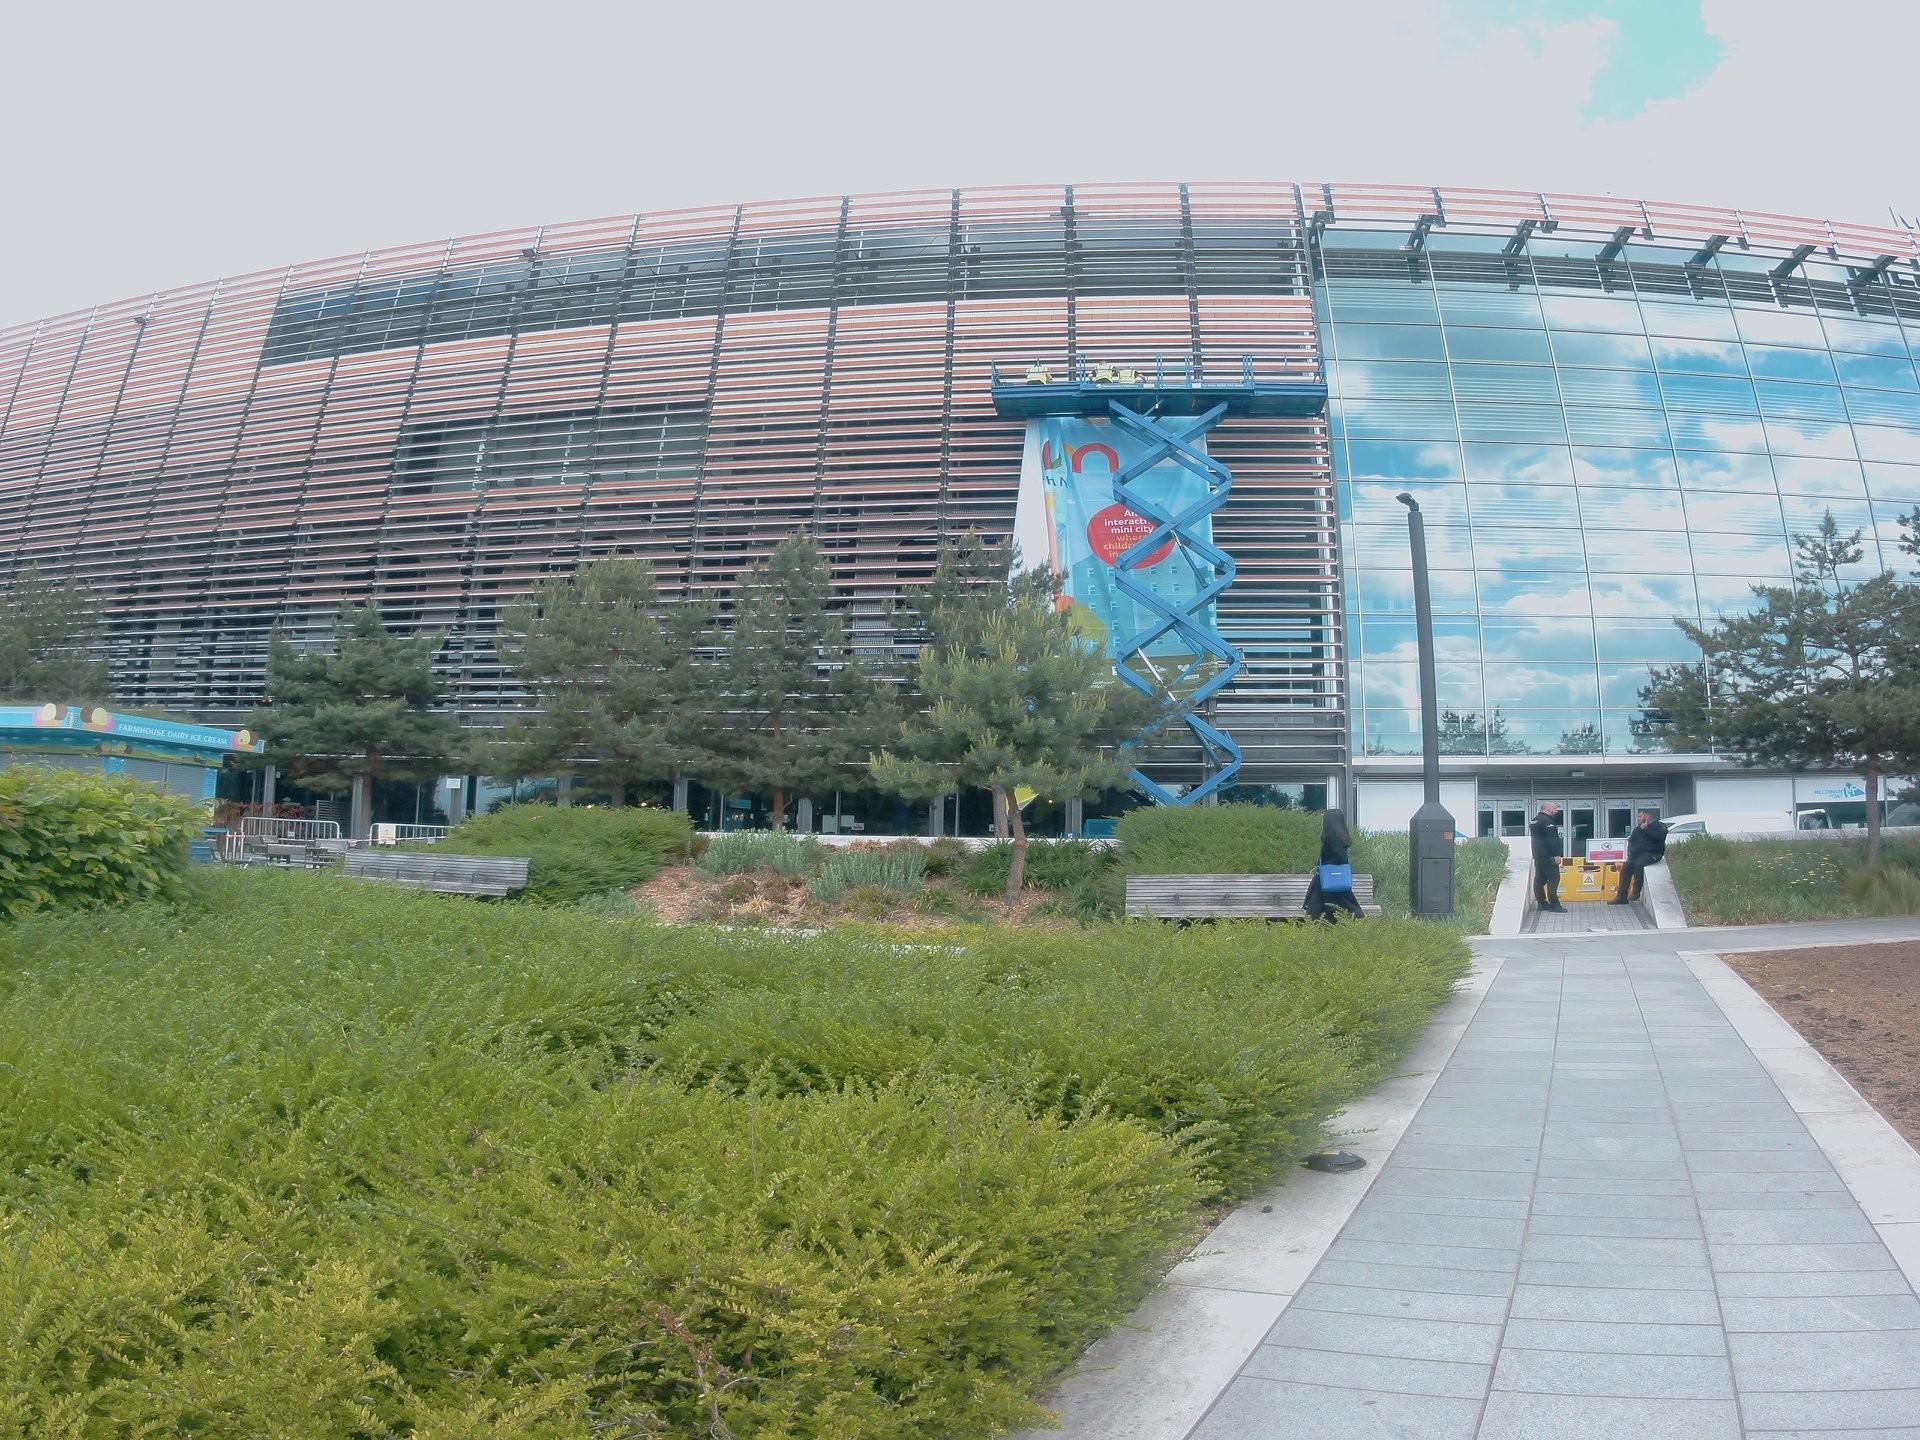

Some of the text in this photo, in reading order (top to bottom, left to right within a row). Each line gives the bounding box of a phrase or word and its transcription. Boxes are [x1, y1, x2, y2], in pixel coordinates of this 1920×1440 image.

[1111, 525, 1154, 534] mini city
[118, 723, 228, 745] FARMHOUSE DAIRY ICE CREAM
